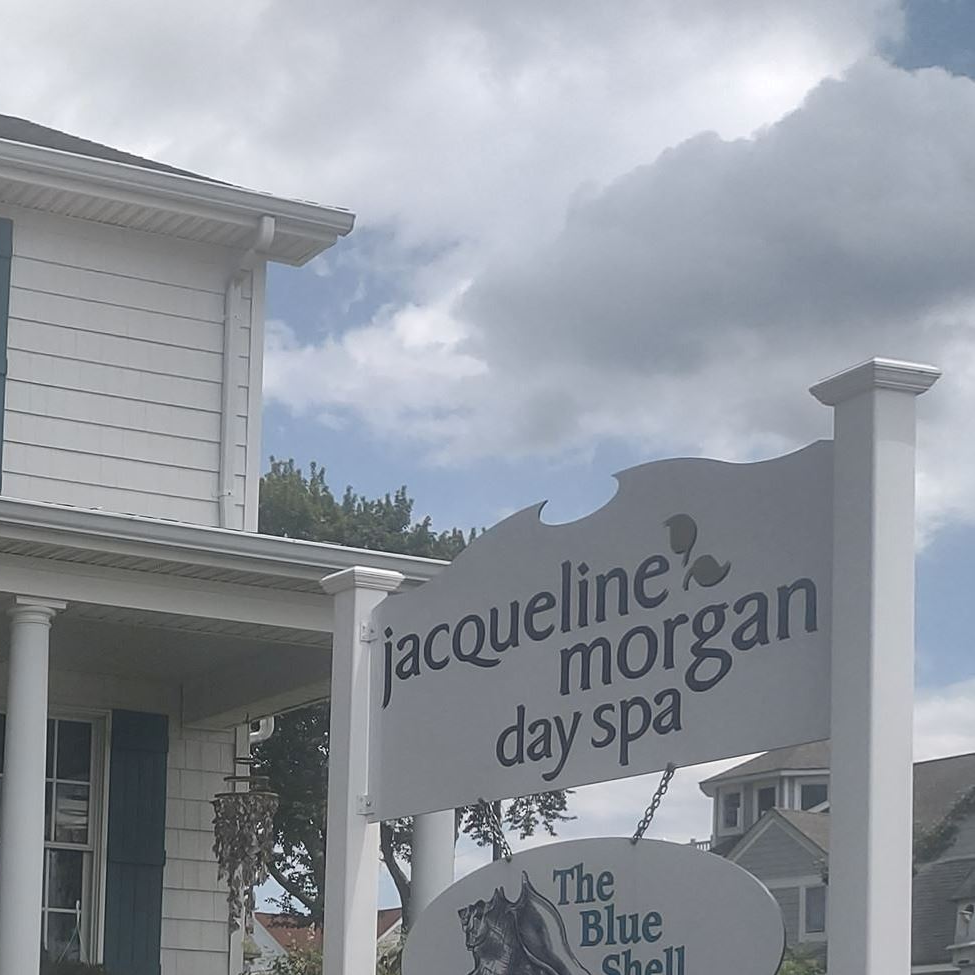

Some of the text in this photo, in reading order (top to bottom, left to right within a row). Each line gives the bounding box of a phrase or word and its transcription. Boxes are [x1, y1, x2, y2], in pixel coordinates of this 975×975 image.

[382, 553, 671, 709] jacqueline
[559, 577, 820, 695] morgan
[496, 688, 683, 782] day spa
[552, 862, 615, 906] The
[579, 903, 663, 947] Blue
